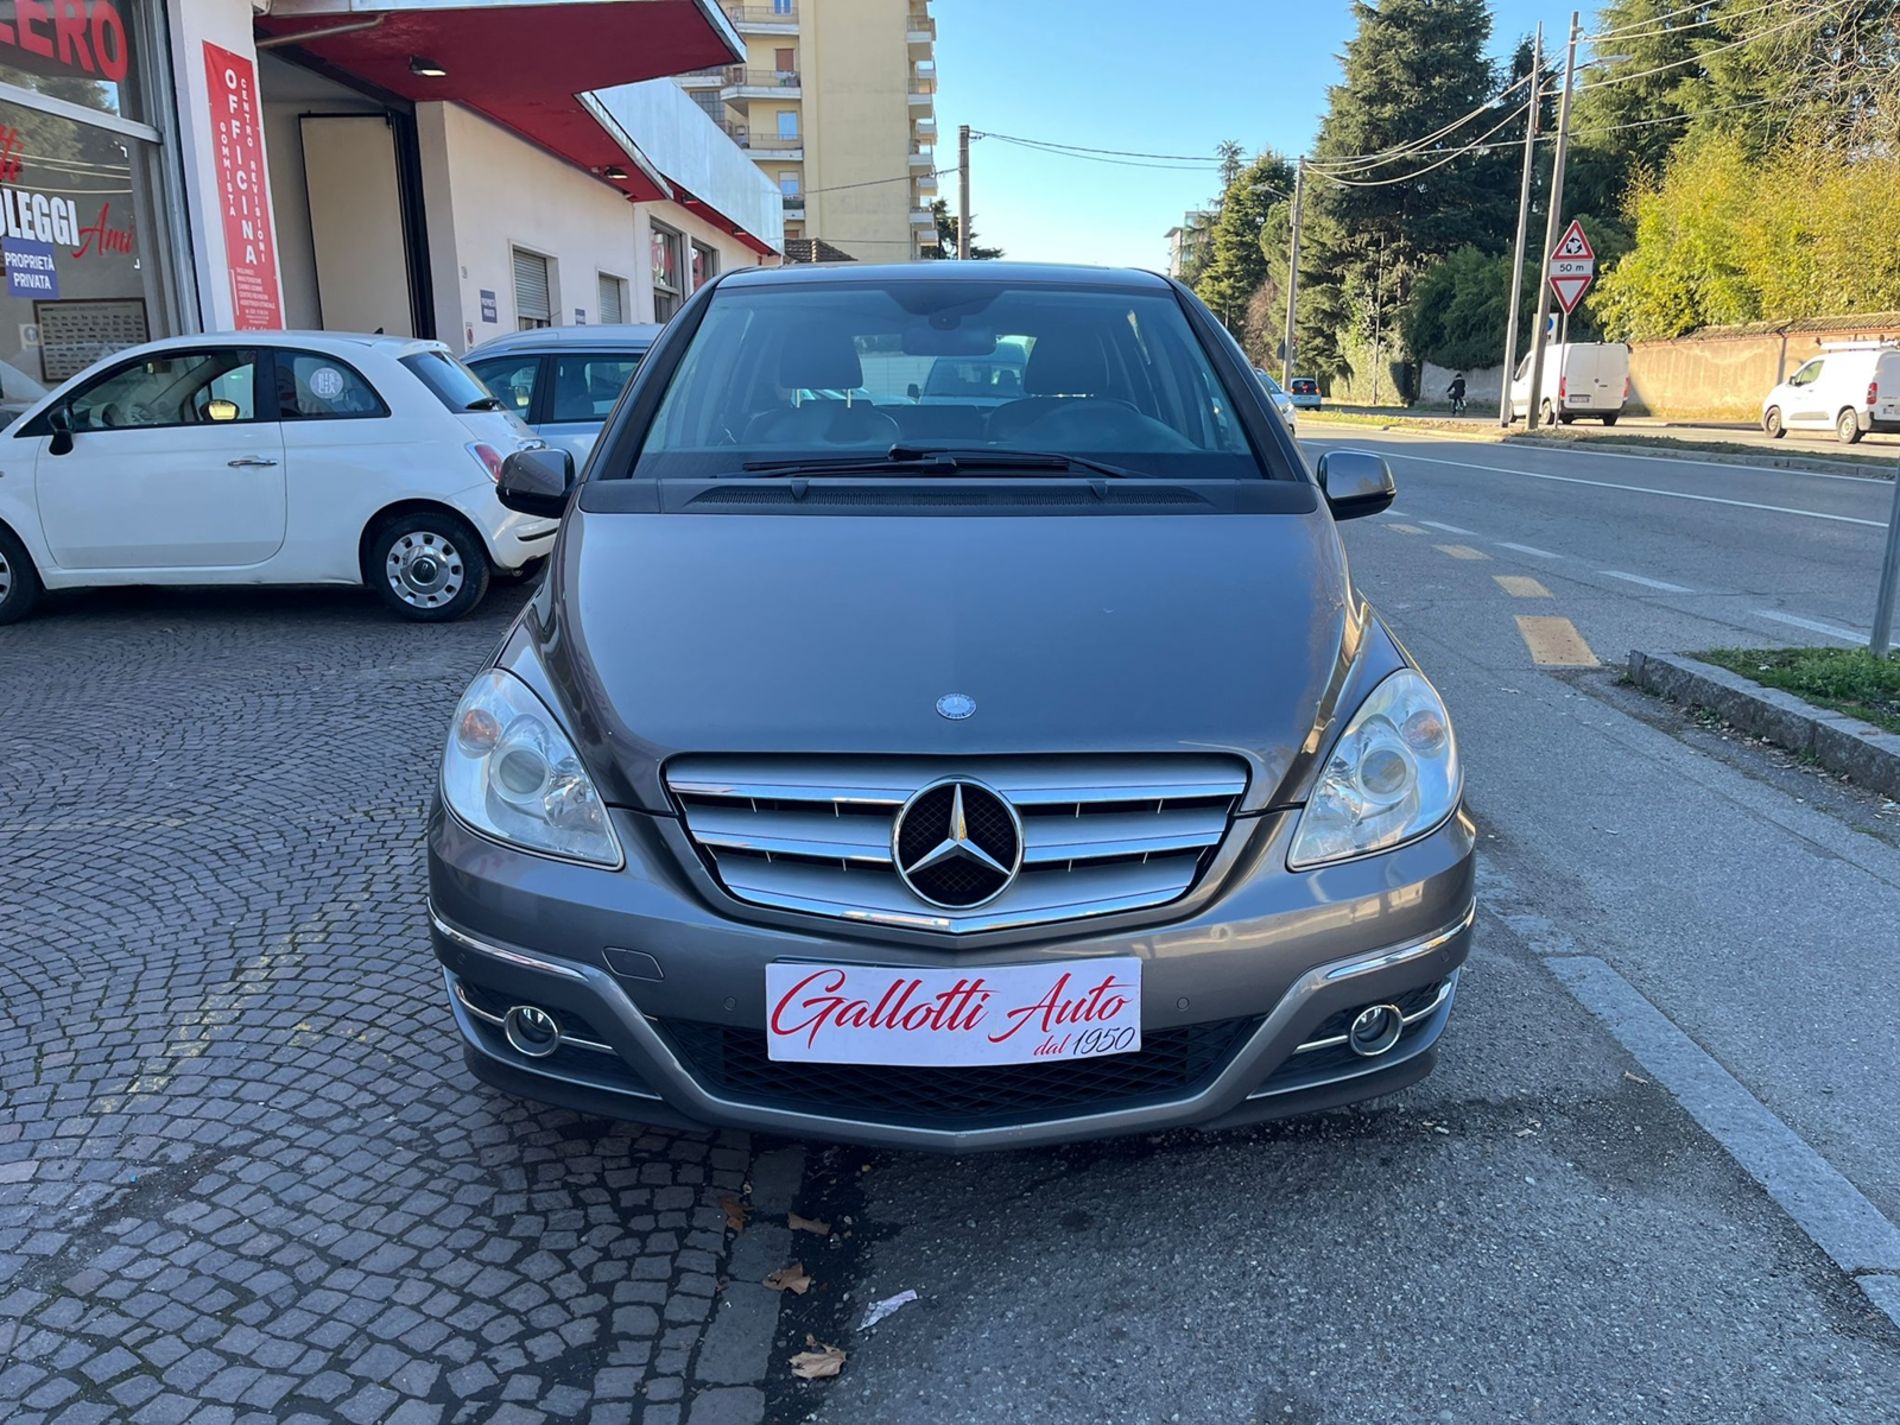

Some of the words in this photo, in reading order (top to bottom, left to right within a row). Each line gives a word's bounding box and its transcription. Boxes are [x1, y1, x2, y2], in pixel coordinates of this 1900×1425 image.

[0, 0, 128, 82] ERO
[220, 121, 236, 216] GOMMISTA
[225, 68, 257, 265] OFFICINA
[241, 78, 253, 147] CENTRO
[250, 160, 265, 263] REVISIONI
[5, 251, 55, 271] PROPRIETÀ
[13, 272, 52, 290] PRIVATA
[1560, 263, 1572, 272] 50
[771, 969, 999, 1049] Gallotti
[988, 972, 1136, 1042] Auto
[1033, 1033, 1072, 1056] dal
[1072, 1026, 1136, 1056] 1950
